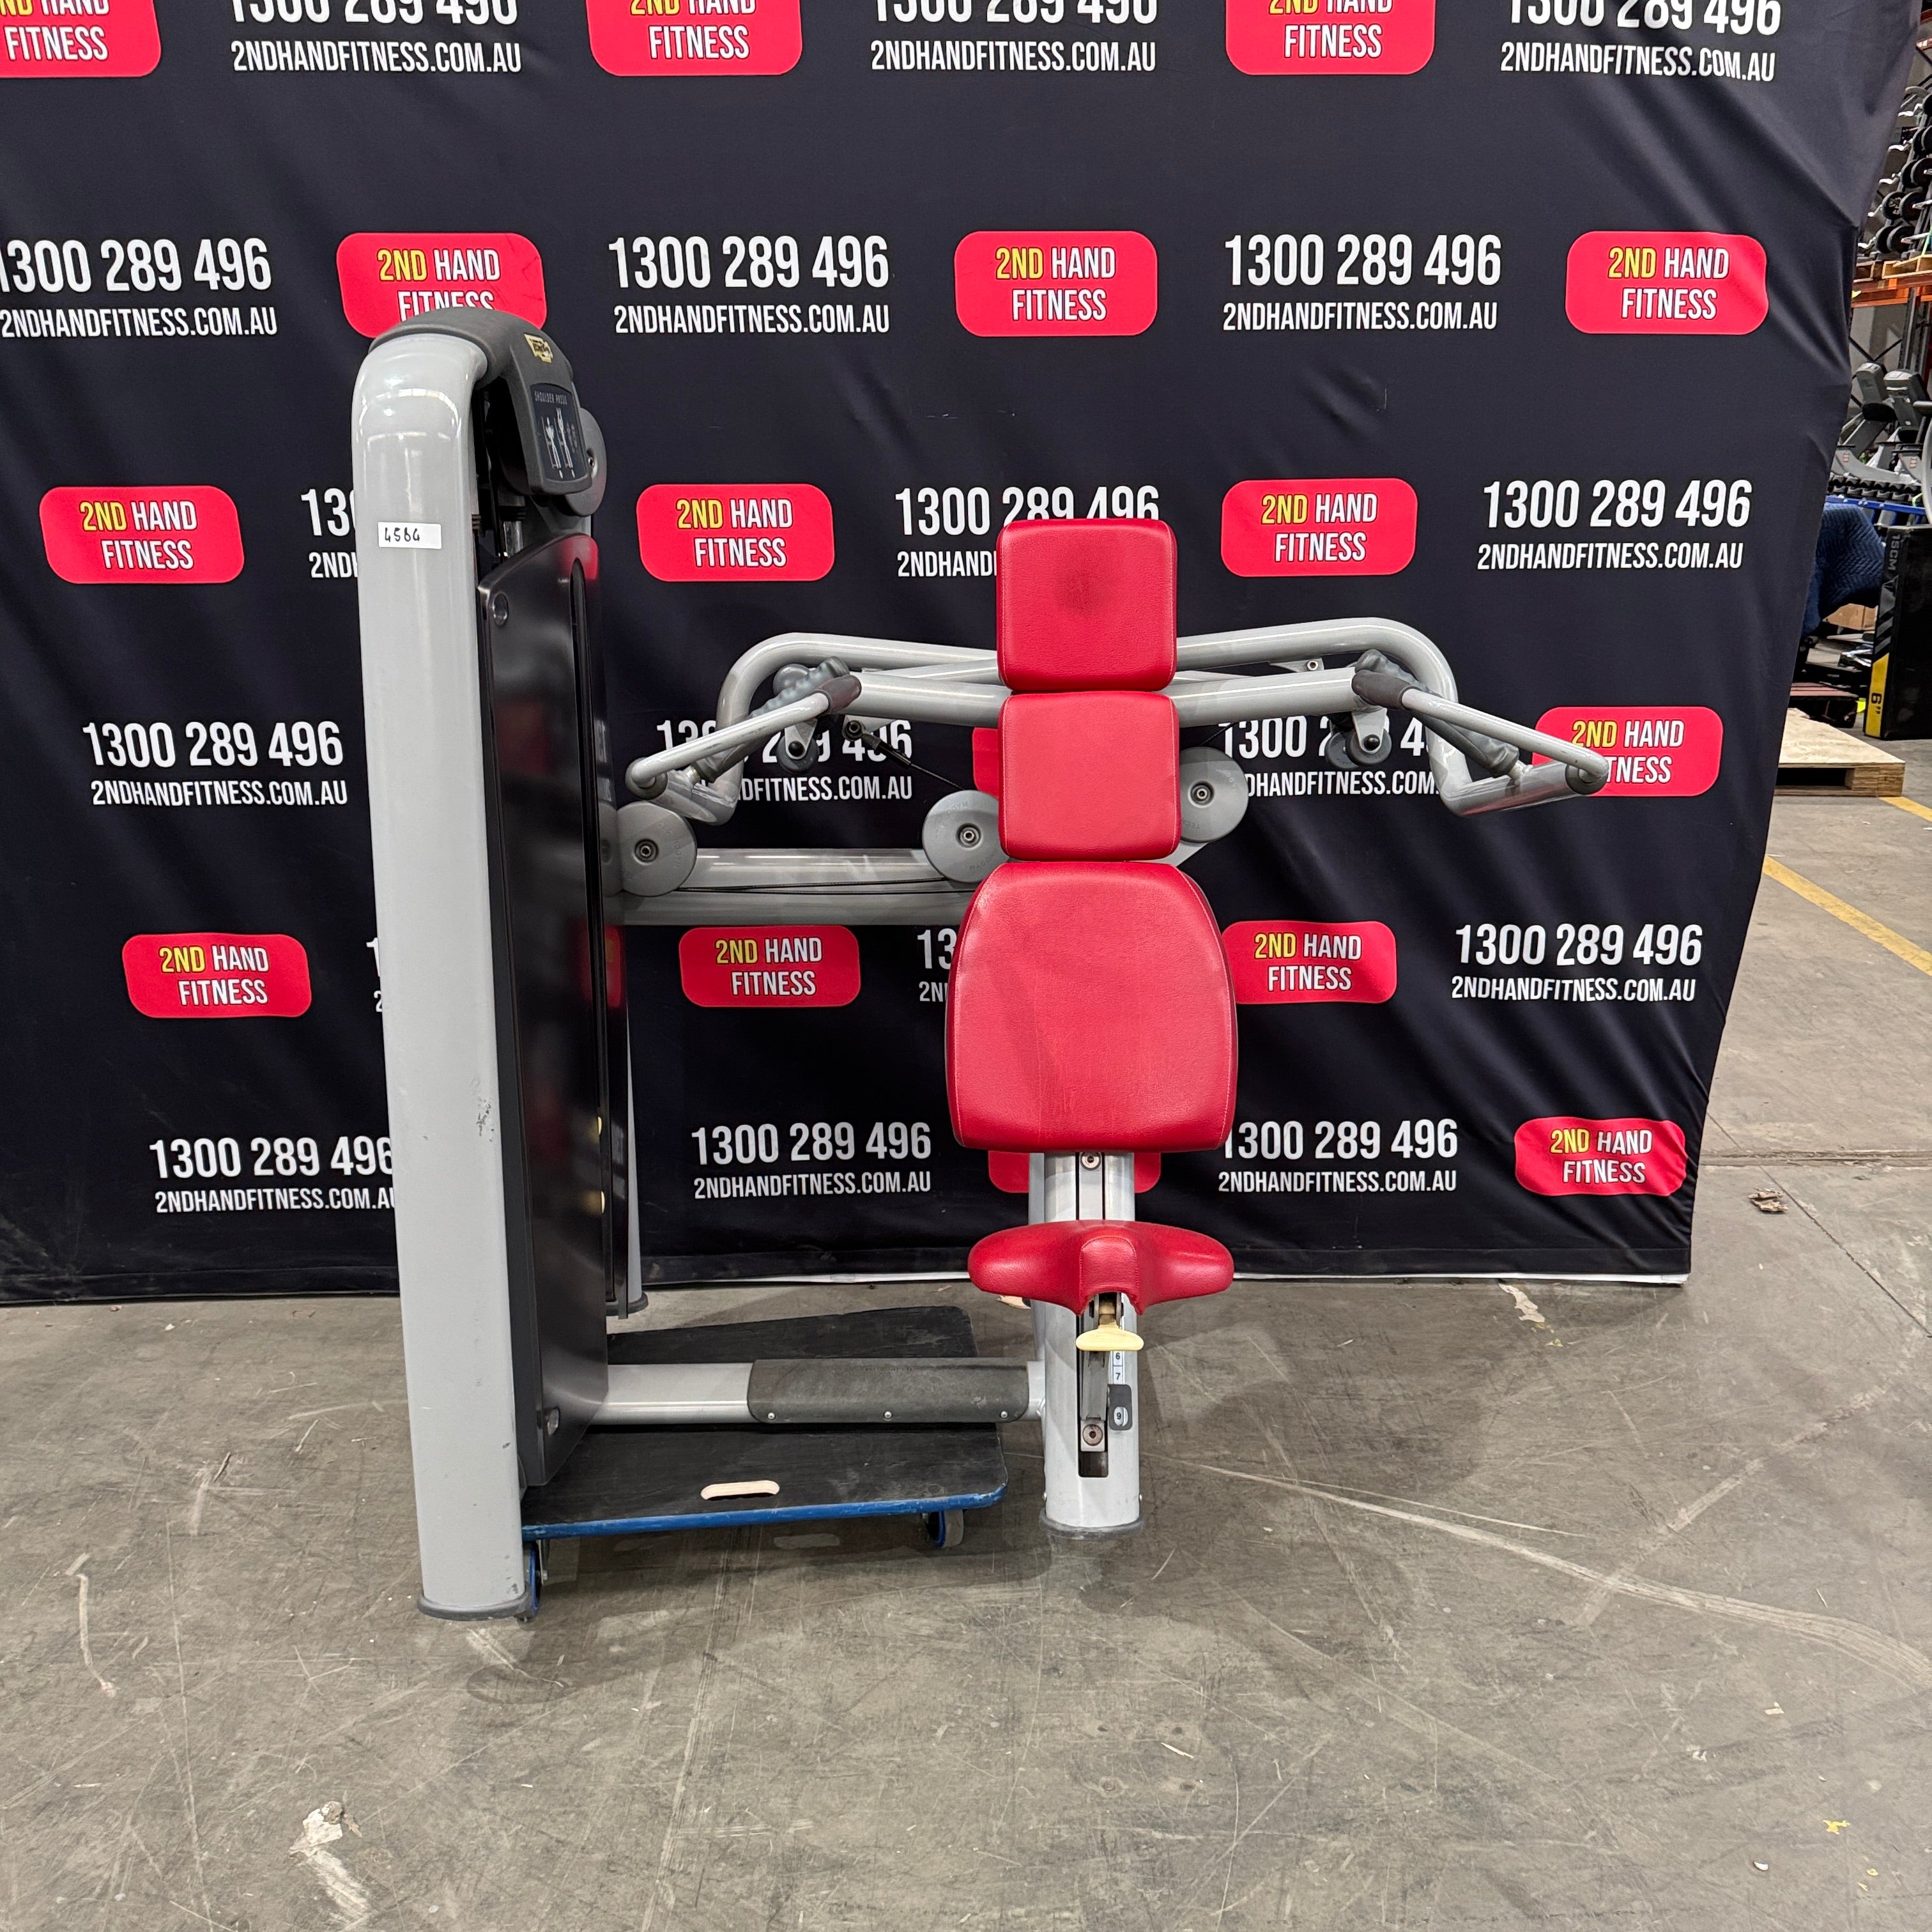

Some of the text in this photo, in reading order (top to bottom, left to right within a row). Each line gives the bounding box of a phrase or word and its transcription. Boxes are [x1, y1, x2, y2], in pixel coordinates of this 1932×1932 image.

[4, 26, 109, 60] FITNESS
[649, 26, 749, 59] FITNESS
[1285, 24, 1382, 57] FITNESS
[231, 41, 521, 72] 2NDHANDFITNESS.COM.AU
[871, 40, 1156, 72] 2NDHANDFITNESS.COM.AU
[1500, 42, 1775, 82] 2NDHANDFITNESS.COM.AU
[100, 239, 182, 292] 289
[194, 238, 272, 291] 496
[377, 249, 500, 280] 2ND HAND
[609, 235, 889, 289] 1300 289 496
[996, 247, 1116, 279] 2ND HAND
[1225, 234, 1501, 286] 1300 289 496
[1609, 247, 1729, 279] 2ND HAND
[1013, 289, 1107, 321] FITNESS
[1223, 302, 1498, 331] 2NDHANDFITNESS.COM.AU
[1621, 288, 1717, 319] FITNESS
[0, 307, 277, 338] 2NDHANDFITNESS.COM.AU
[614, 305, 889, 334] 2NDHANDFITNESS.COM.AU
[80, 501, 197, 531] 2ND HAND
[676, 499, 793, 528] 2ND HAND
[895, 486, 1159, 535] 1300 289 496
[1261, 493, 1377, 524] 2ND HAND
[1483, 480, 1752, 528] 1300 289 496
[385, 526, 420, 542] 4564
[1275, 532, 1367, 562] FITNESS
[101, 540, 194, 569] FITNESS
[694, 537, 786, 567] FITNESS
[1477, 542, 1744, 571] 2NDHANDFITNESS.COM.AU
[1887, 533, 1900, 571] 15CM
[83, 721, 343, 768] 1300 289 496
[1572, 720, 1685, 747] 2ND HAND
[1604, 756, 1672, 783] TNESS
[91, 780, 348, 806] 2NDHANDFITNESS.COM.AU
[160, 946, 269, 972] 2ND HAND
[716, 937, 822, 963] 2ND HAND
[1254, 933, 1361, 960] 2ND HAND
[1455, 923, 1703, 966] 1300 289 496
[178, 979, 268, 1005] FITNESS
[732, 970, 816, 995] FITNESS
[1268, 965, 1352, 991] FITNESS
[1452, 976, 1696, 1002] 2NDHANDFITNESS.COM.AU
[691, 1122, 931, 1165] 1300 289 496
[1224, 1118, 1458, 1160] 1300 289 496
[1550, 1128, 1652, 1155] 2ND HAND
[150, 1136, 393, 1179] 1300 289 496
[1563, 1159, 1646, 1183] FITNESS
[694, 1171, 931, 1199] 2NDHANDFITNESS.COM.AU
[1218, 1170, 1457, 1193] 2NDHANDFITNESS.COM.AU
[1115, 1352, 1121, 1360] 6
